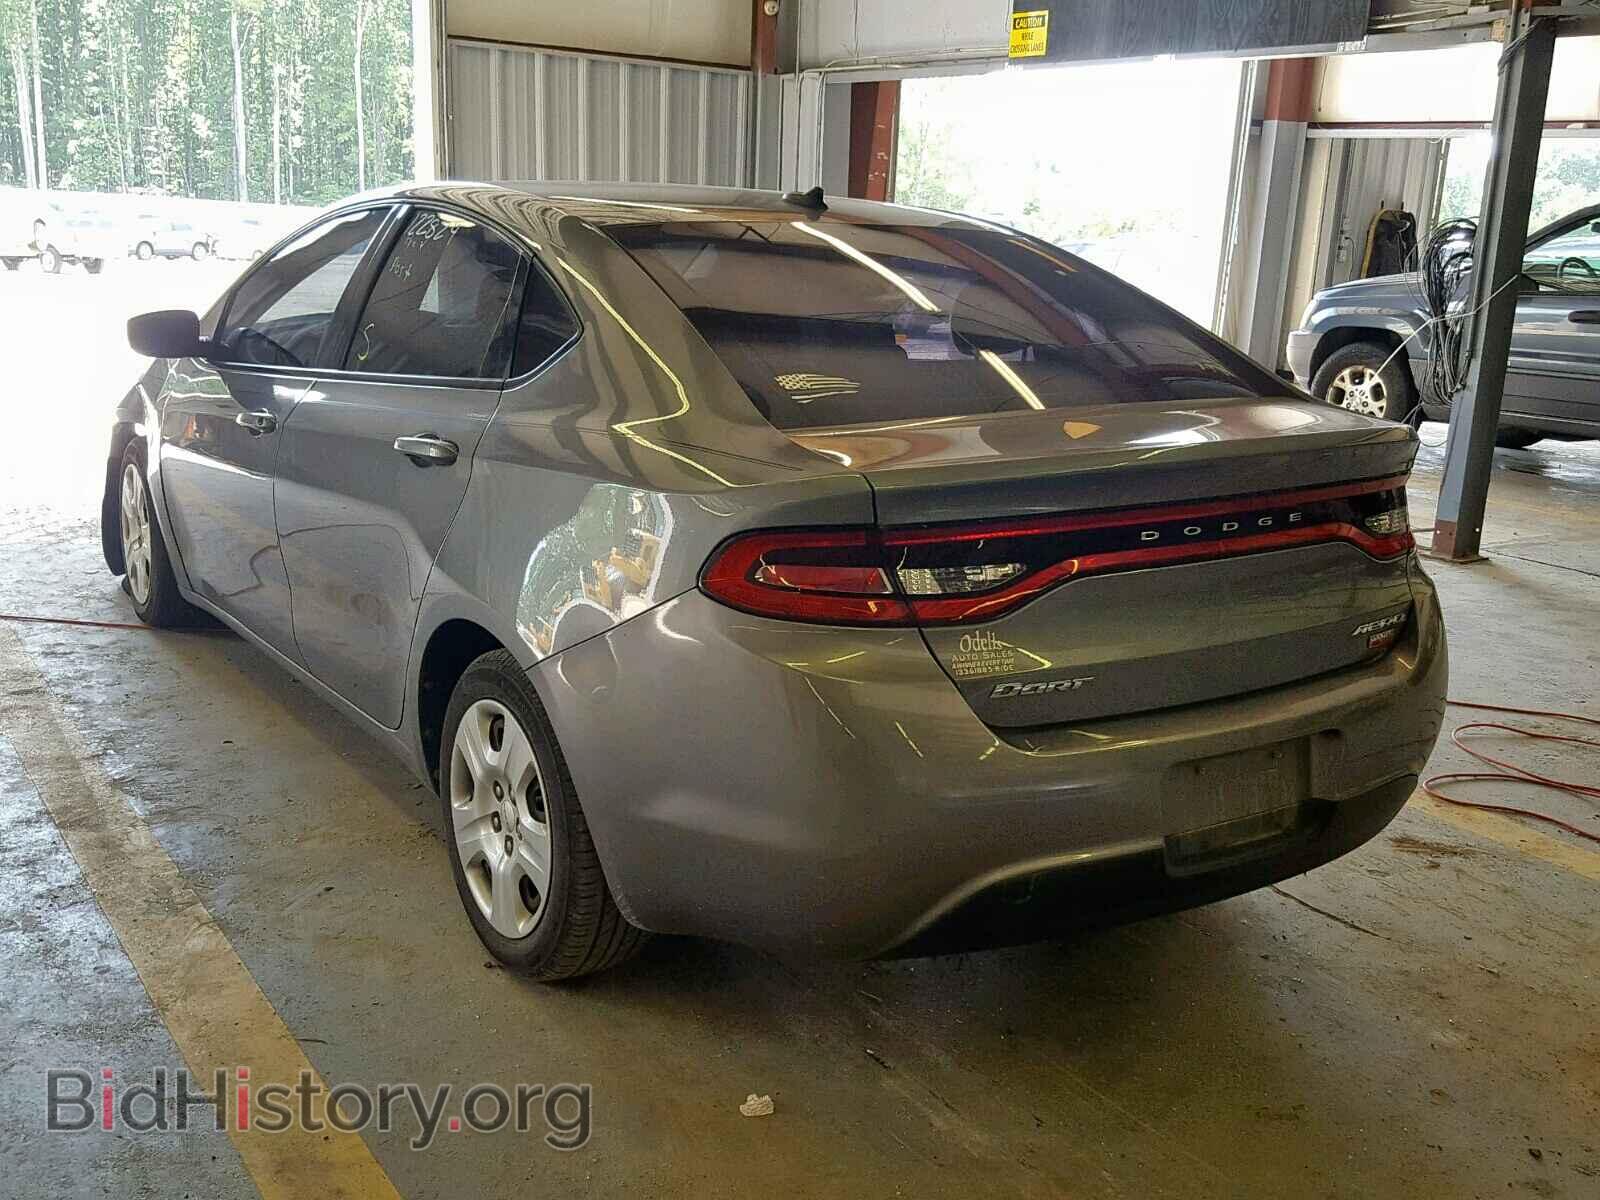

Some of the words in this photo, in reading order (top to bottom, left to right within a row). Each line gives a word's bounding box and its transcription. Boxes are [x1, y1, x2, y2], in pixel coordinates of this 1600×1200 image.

[1015, 16, 1043, 29] CAUTION
[1140, 512, 1302, 541] DODGE
[952, 652, 979, 662] AUTO
[982, 649, 1015, 660] SALES
